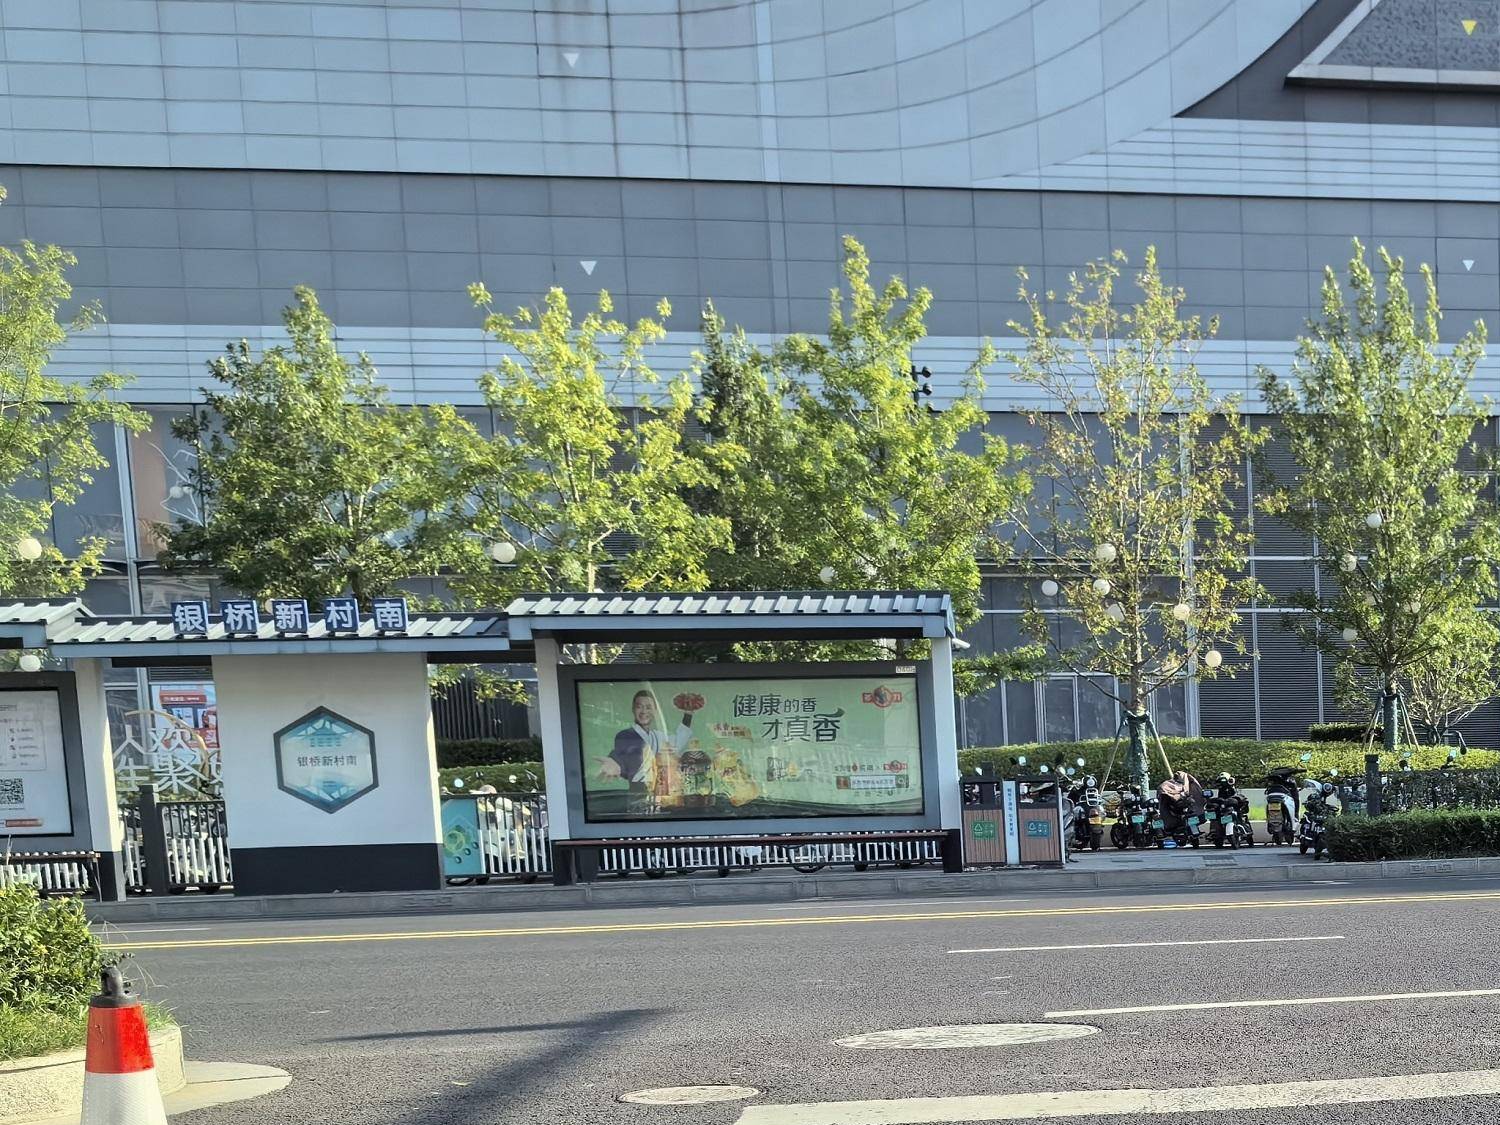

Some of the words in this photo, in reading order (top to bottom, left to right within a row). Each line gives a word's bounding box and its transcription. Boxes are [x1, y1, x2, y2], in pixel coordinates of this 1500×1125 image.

[174, 603, 402, 631] 银桥新村南
[732, 693, 817, 717] 健康的香
[761, 708, 845, 742] 才真香
